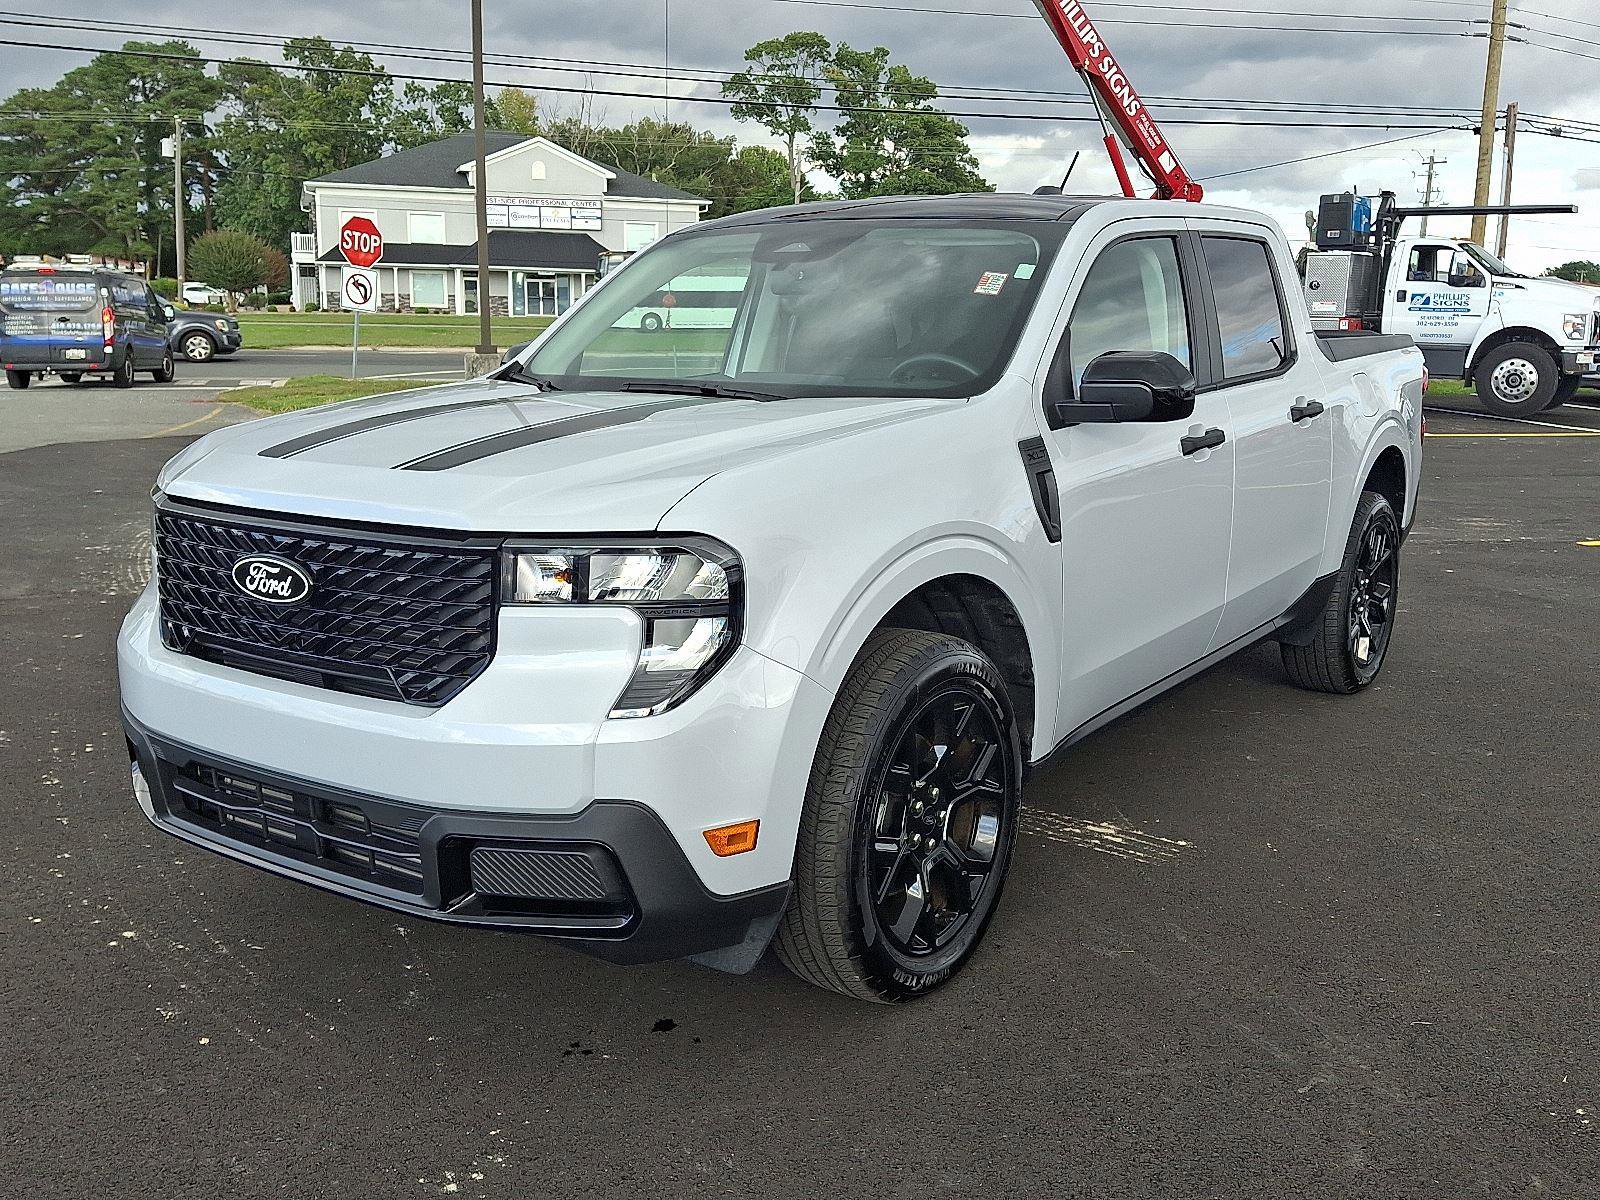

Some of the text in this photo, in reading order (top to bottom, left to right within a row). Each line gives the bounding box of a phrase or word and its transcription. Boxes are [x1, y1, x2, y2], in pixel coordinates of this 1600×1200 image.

[1098, 56, 1141, 116] SIGNS
[486, 197, 516, 205] ST-SIDE
[519, 198, 567, 206] PROFESSIONAL
[342, 229, 380, 254] STOP
[1433, 293, 1470, 301] PHILLIPS
[246, 562, 293, 597] Ford
[951, 661, 998, 689] WRANGLER
